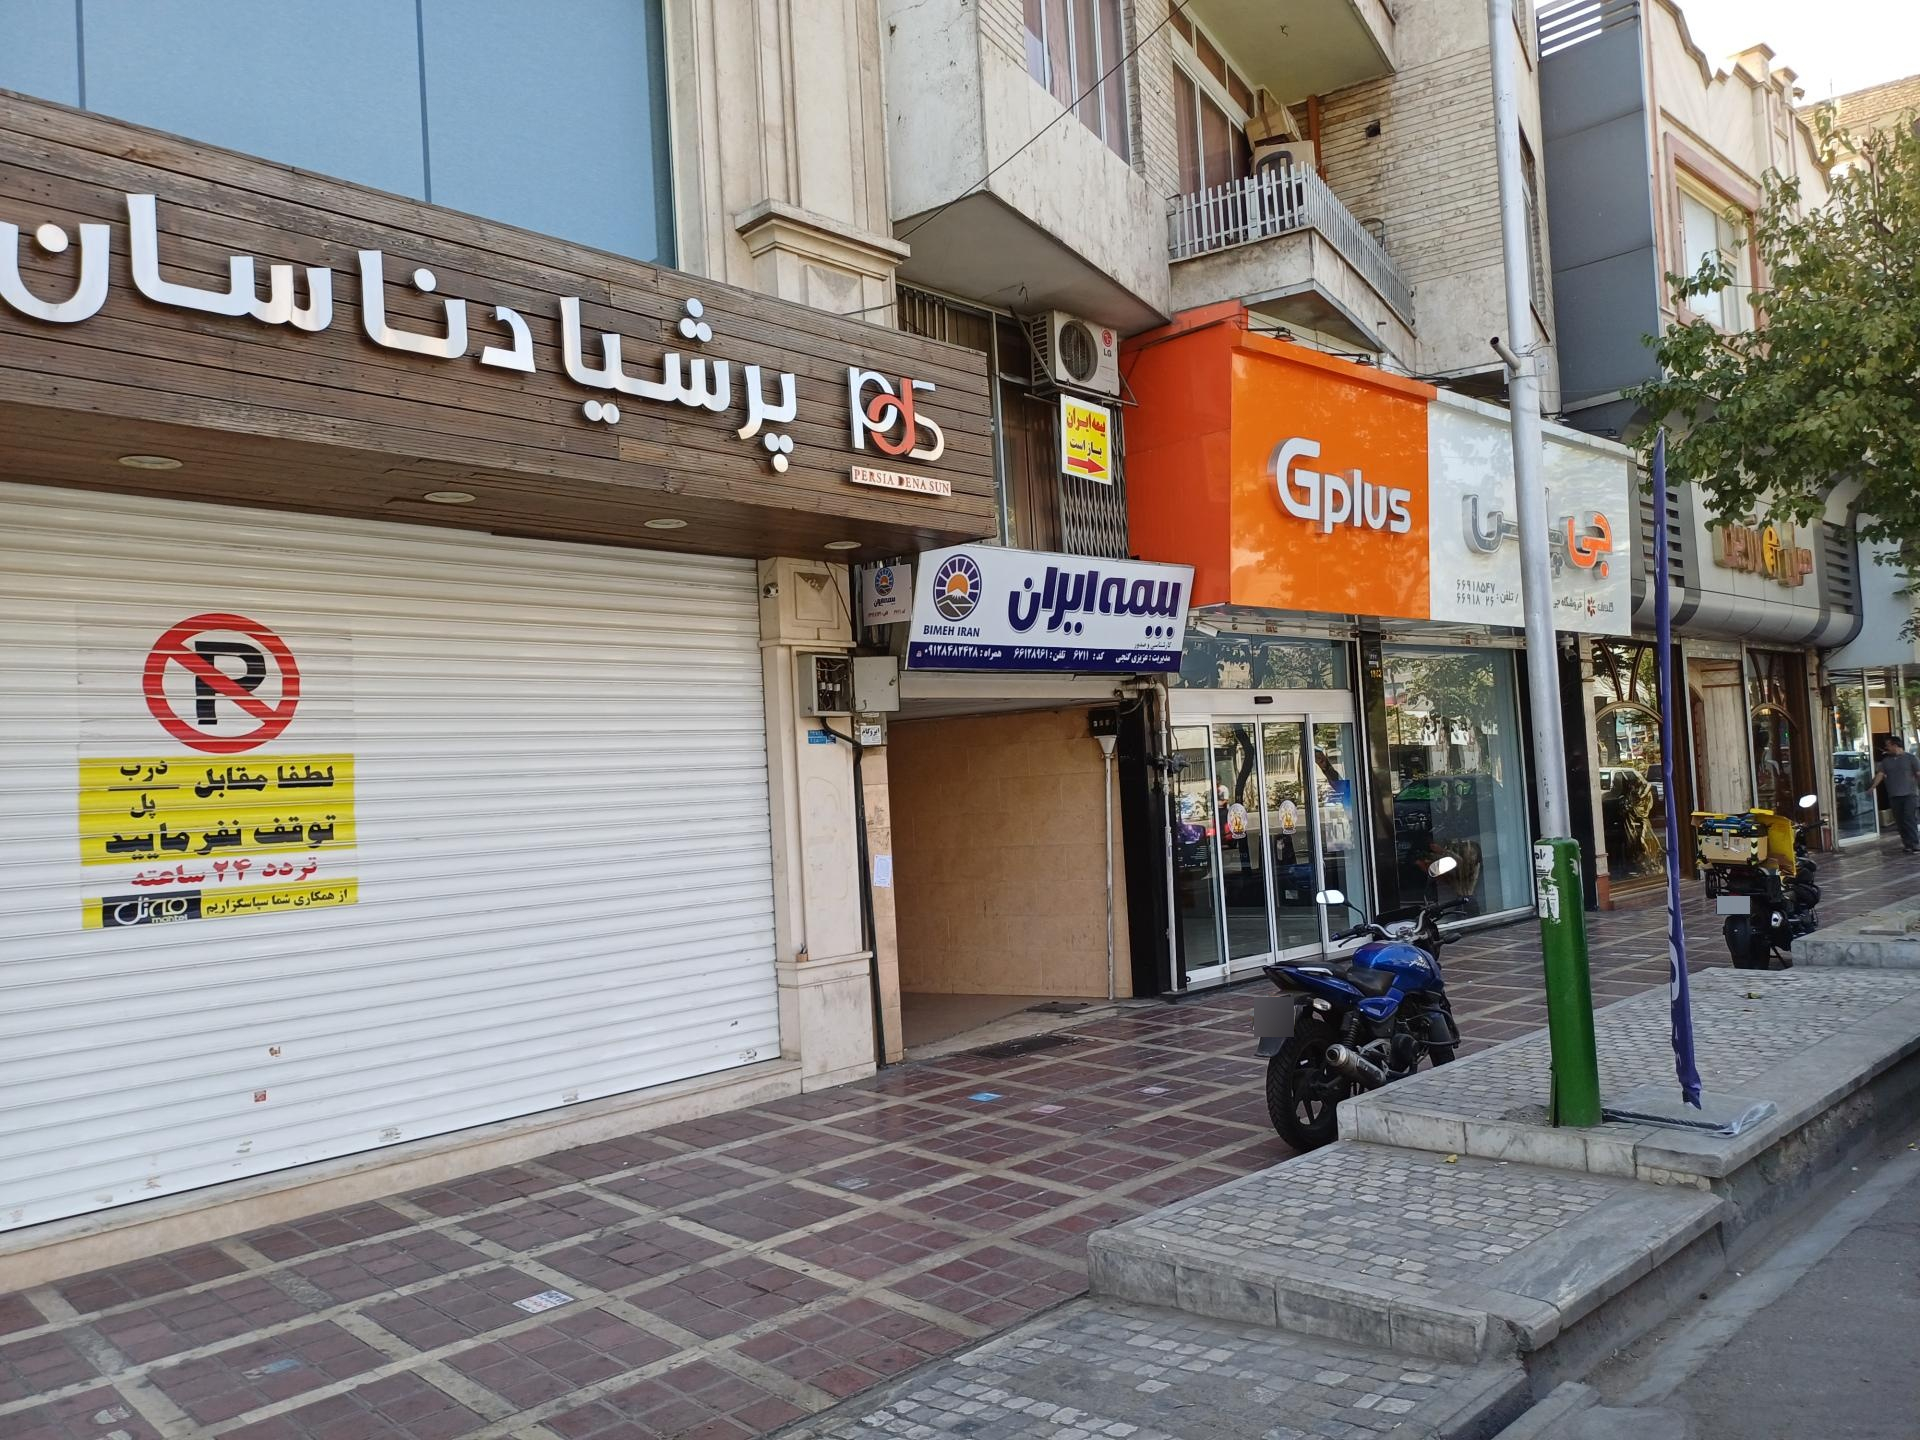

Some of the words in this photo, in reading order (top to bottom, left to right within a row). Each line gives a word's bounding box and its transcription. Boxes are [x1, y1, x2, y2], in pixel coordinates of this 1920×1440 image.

[0, 193, 333, 332] سان
[358, 249, 536, 374] دنا
[559, 296, 797, 473] پرشیا
[1066, 407, 1092, 432] ایران
[1092, 417, 1106, 438] بیمه
[1070, 438, 1085, 450] است
[1087, 441, 1102, 458] باز
[854, 468, 894, 486] PERSIA
[897, 475, 926, 491] DENA
[929, 481, 950, 494] SUN
[1268, 437, 1412, 534] Gplus
[1008, 566, 1099, 634] ایران
[1099, 577, 1182, 638] بیمه
[923, 625, 955, 636] BIMEH
[957, 626, 980, 637] IRAN
[1073, 649, 1089, 660] ۶۷۱۱
[120, 760, 168, 782] درب
[194, 767, 268, 799] مقابل
[277, 765, 335, 788] لطفا
[130, 793, 157, 820] پل
[253, 815, 336, 849] توقف
[131, 864, 207, 887] ساعته
[212, 858, 252, 883] ۲۴
[261, 857, 319, 882] تردد
[271, 893, 291, 906] شما
[293, 890, 335, 907] همکاری
[338, 888, 349, 903] از
